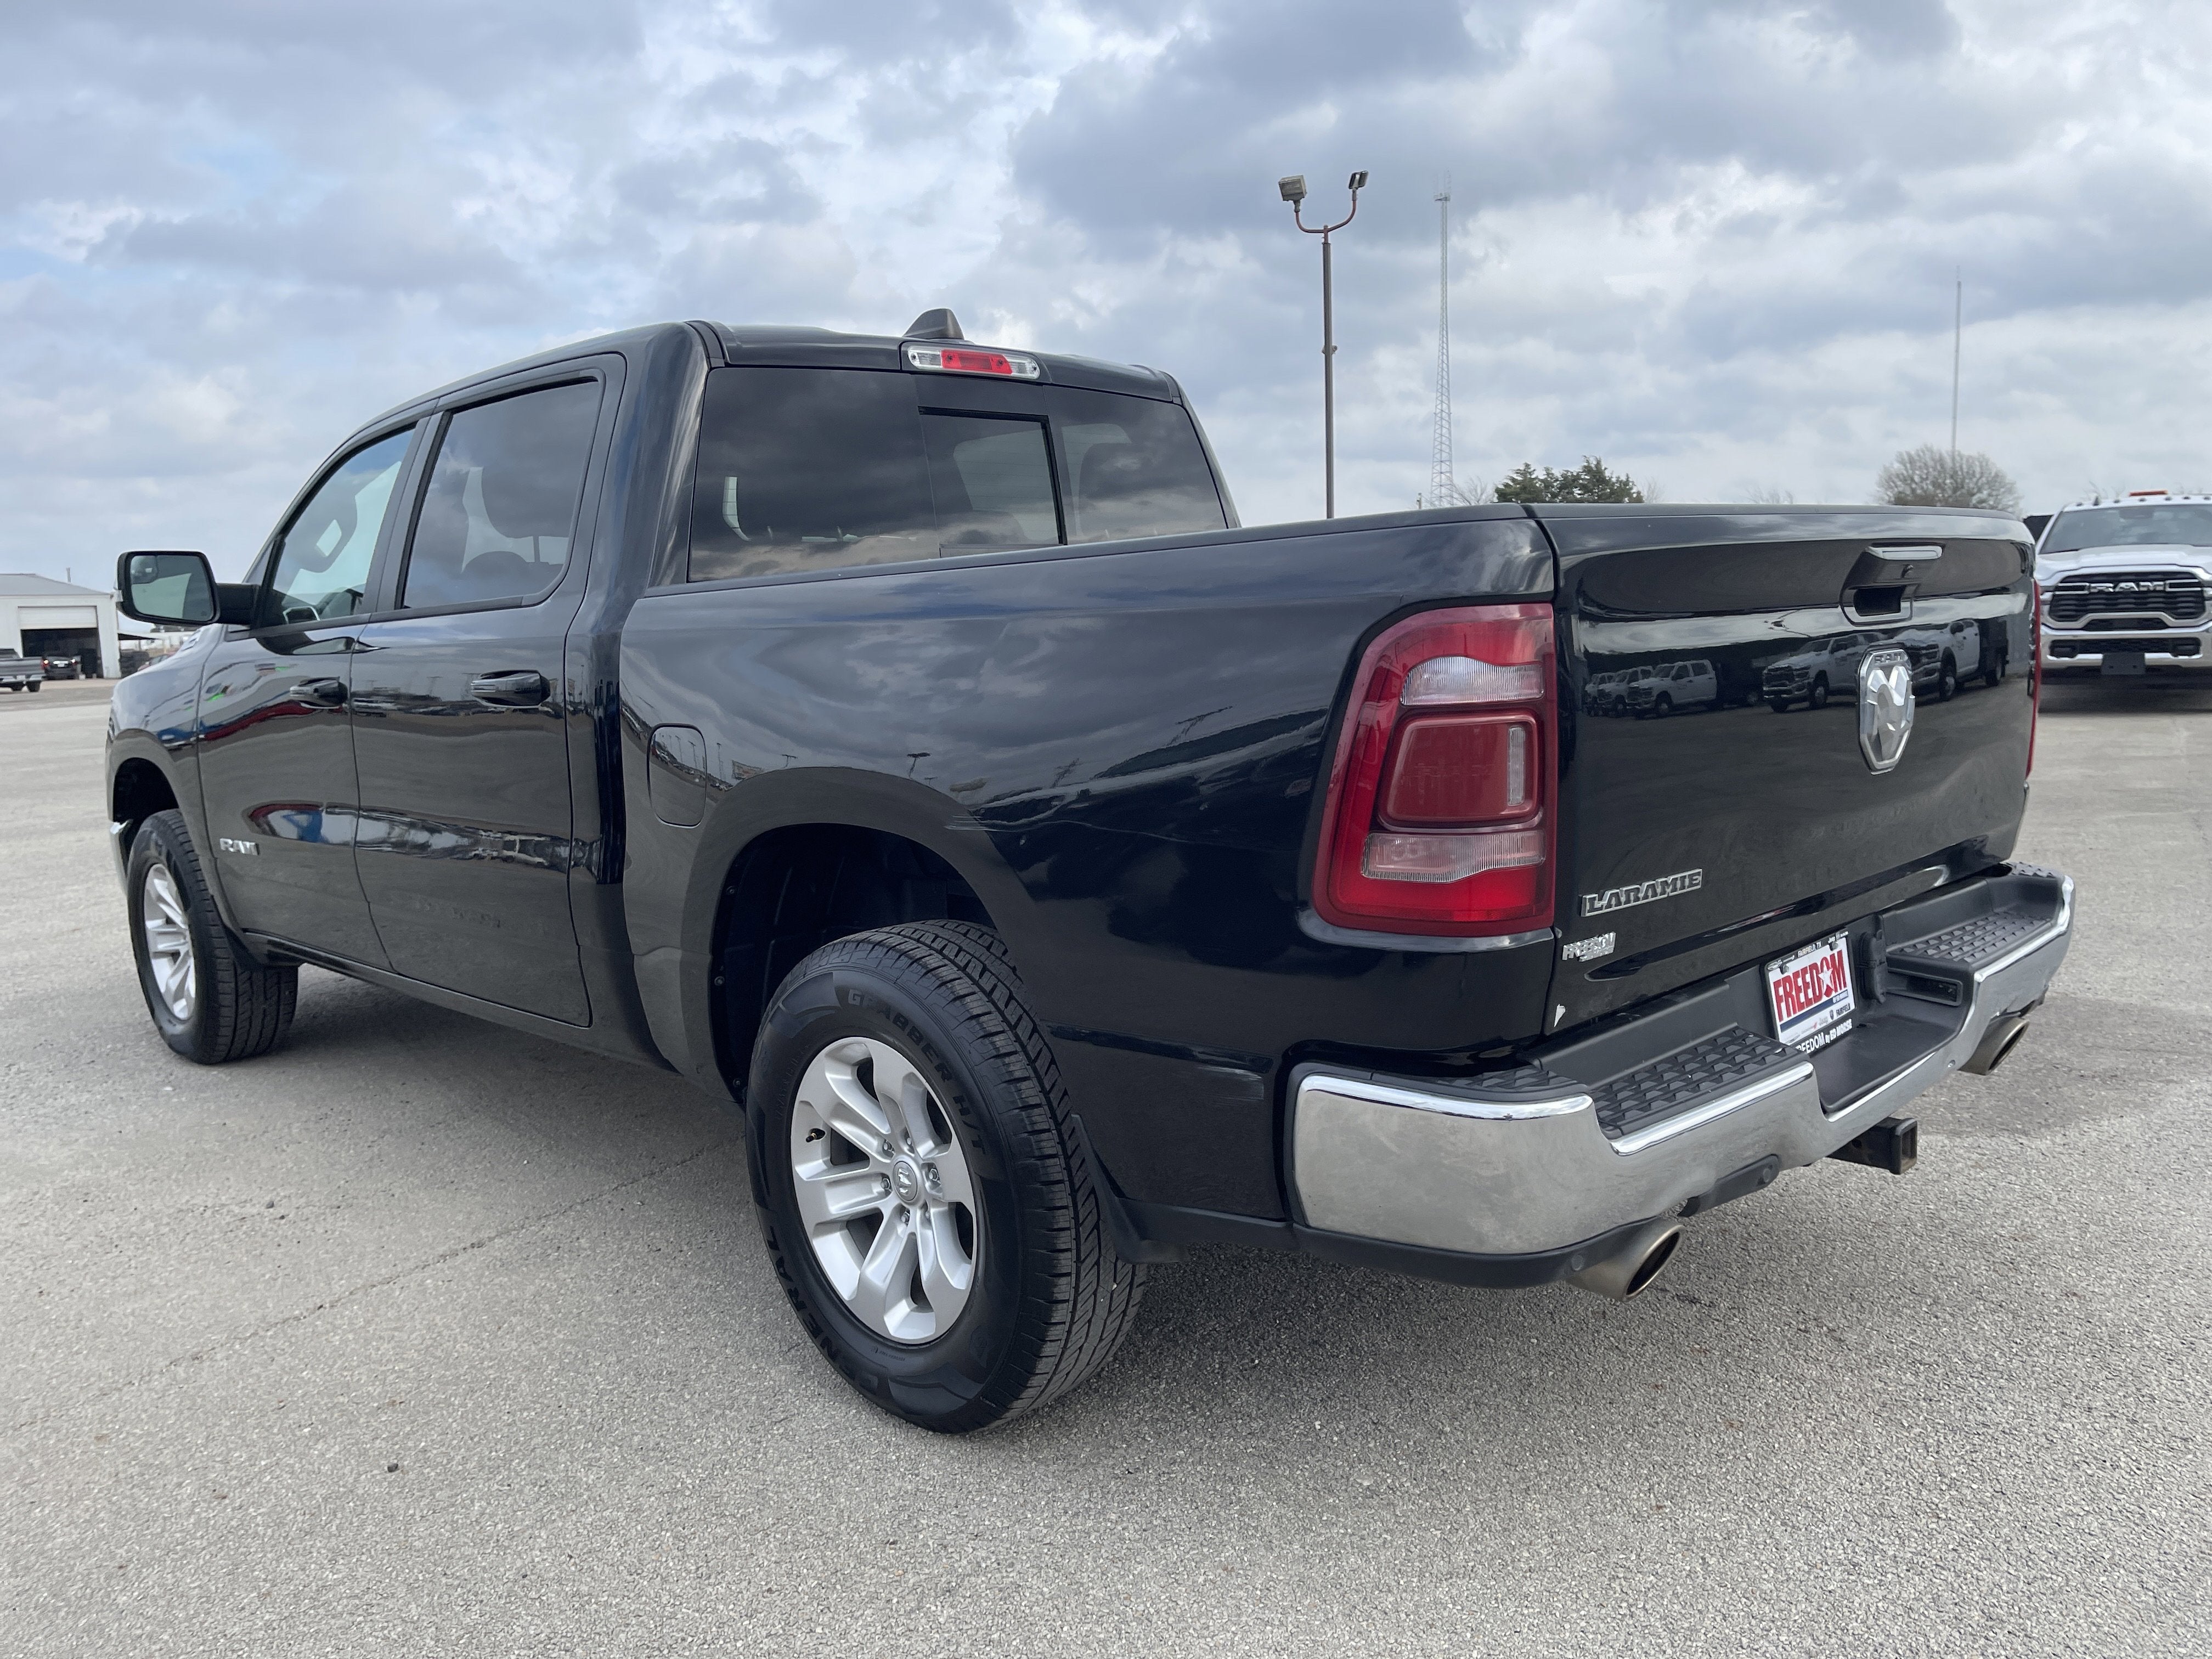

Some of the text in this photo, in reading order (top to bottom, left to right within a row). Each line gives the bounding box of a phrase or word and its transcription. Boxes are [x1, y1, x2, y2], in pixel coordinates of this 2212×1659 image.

[2090, 582, 2165, 592] RAM
[1874, 653, 1901, 663] RAM
[220, 838, 260, 856] RAM
[1581, 868, 1702, 917] LARAMIE
[1773, 949, 1847, 1022] FREEDOM
[1795, 1032, 1825, 1053] REEDOM
